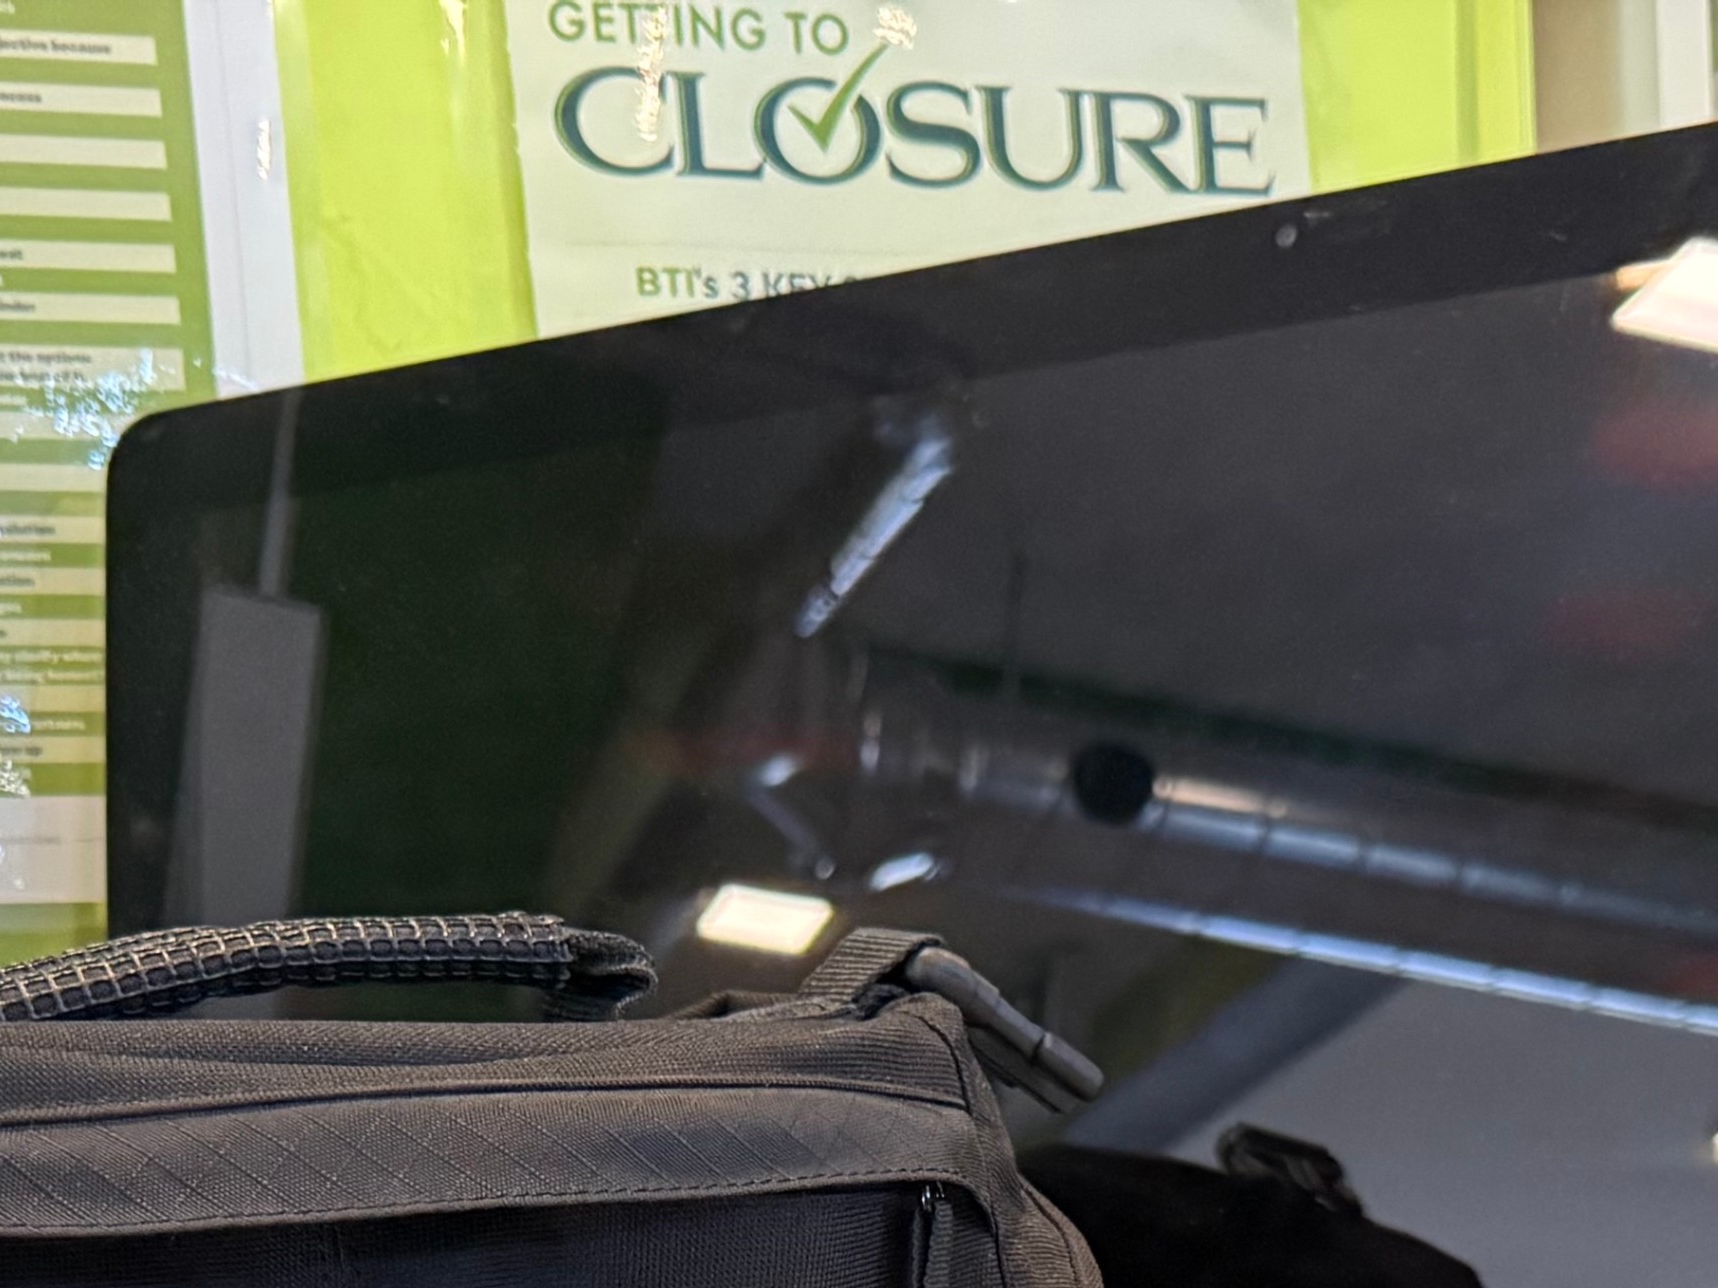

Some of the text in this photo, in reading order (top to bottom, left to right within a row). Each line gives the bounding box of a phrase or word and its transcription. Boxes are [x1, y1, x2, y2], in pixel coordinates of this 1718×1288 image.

[783, 11, 849, 55] TO
[553, 65, 1276, 196] CLOSURE
[636, 266, 719, 298] BTI's
[732, 271, 750, 300] 3
